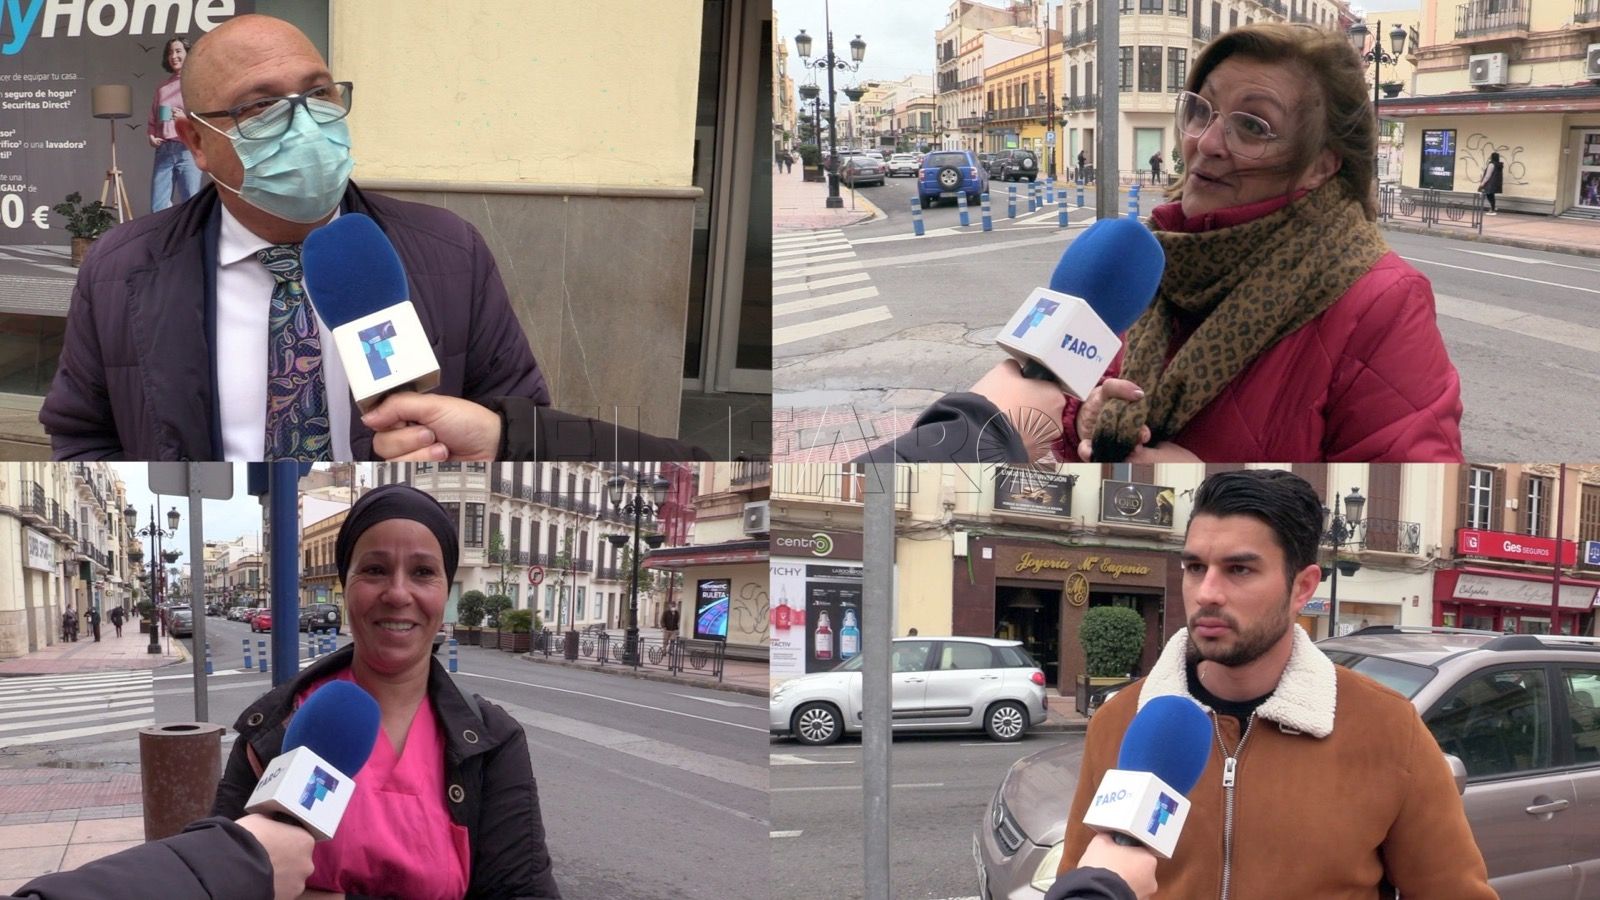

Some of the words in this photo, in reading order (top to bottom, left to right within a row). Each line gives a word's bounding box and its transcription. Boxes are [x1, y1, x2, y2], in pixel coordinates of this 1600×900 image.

[5, 91, 33, 100] seguro
[35, 90, 46, 98] de
[2, 101, 40, 110] Securitas
[1060, 333, 1098, 360] FARO
[1503, 540, 1522, 553] Ges
[1522, 546, 1549, 556] SEGUROS
[1100, 557, 1151, 579] Eugenia
[702, 591, 726, 599] RULETA
[1096, 789, 1126, 806] FARO
